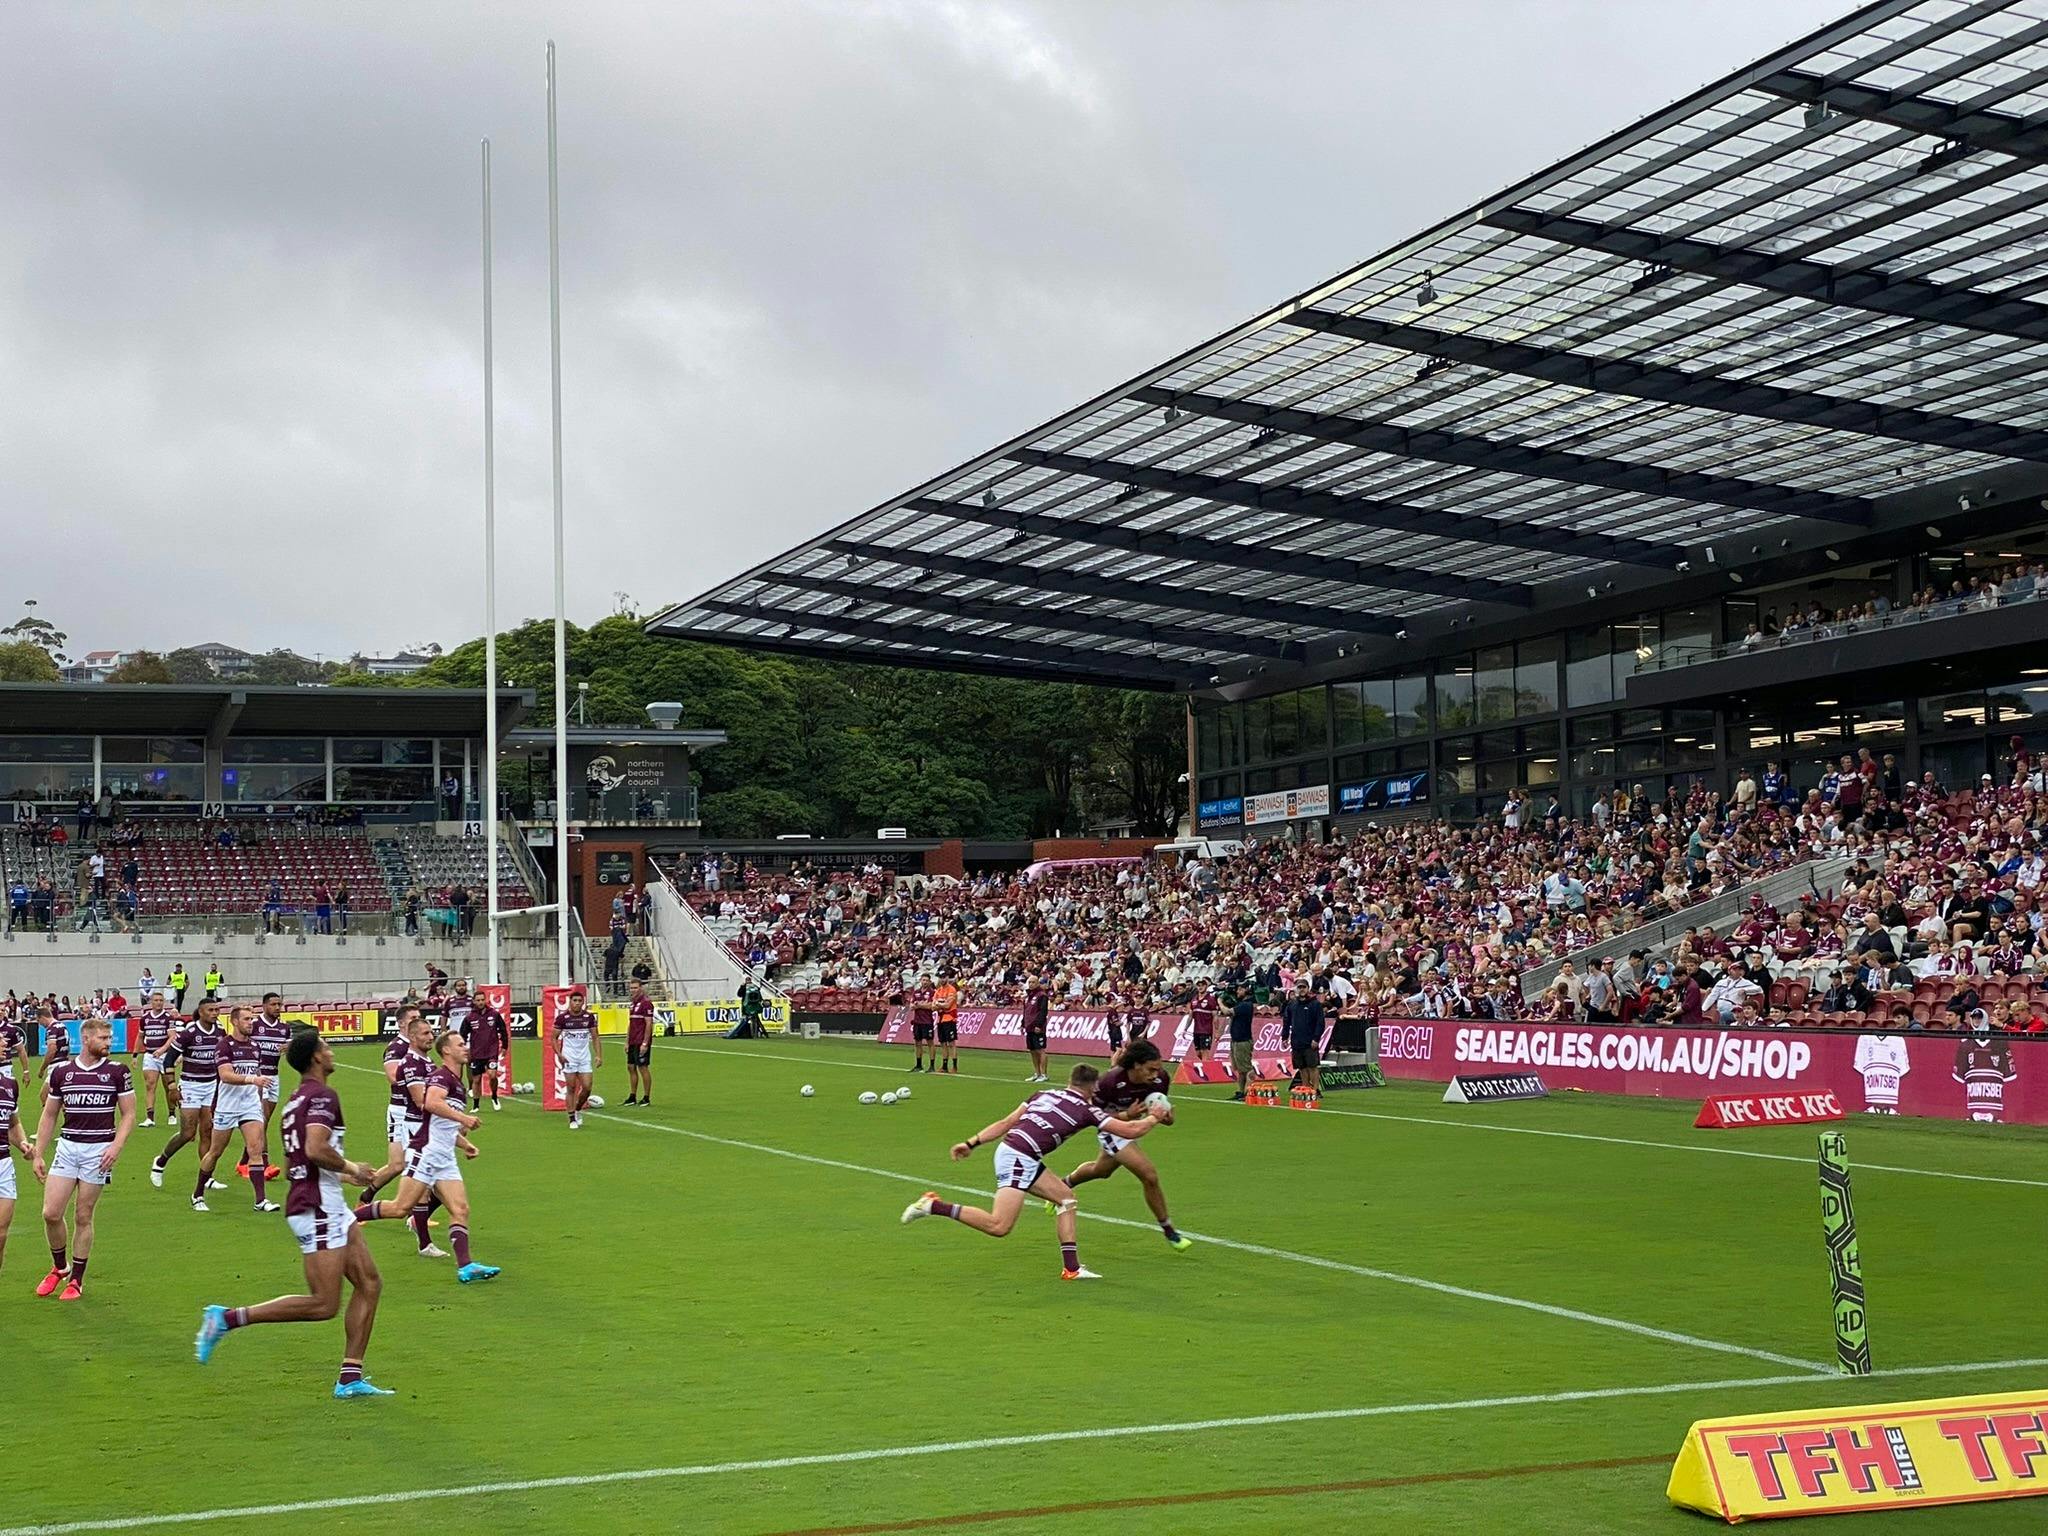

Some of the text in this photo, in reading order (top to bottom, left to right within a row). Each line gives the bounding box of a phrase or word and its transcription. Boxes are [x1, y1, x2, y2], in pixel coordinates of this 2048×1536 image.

[627, 760, 664, 768] northern
[627, 769, 664, 777] beaches
[627, 778, 659, 786] council
[1255, 796, 1284, 811] BAYWASH
[1297, 789, 1328, 806] BAYWASH
[17, 803, 33, 818] A1
[205, 803, 222, 818] A2
[1200, 819, 1219, 829] Solutions
[1220, 816, 1241, 826] Solutions
[464, 823, 481, 836] A3
[836, 855, 877, 864] BREWING
[880, 854, 897, 863] CO.
[706, 1007, 739, 1023] URM
[314, 1015, 357, 1032] TFH
[956, 1011, 987, 1035] ERCH
[1378, 1025, 1433, 1060] ERCH
[1454, 1028, 1811, 1080] SEAEAGLES.COM.AU/SHOP
[1333, 1071, 1371, 1085] PROJECTS
[1866, 1074, 1898, 1089] POINTSBET
[1461, 1077, 1544, 1098] SPORTSCRAFT
[1967, 1082, 2003, 1098] POINTSBET
[63, 1093, 111, 1106] POINTSBET
[1716, 1093, 1842, 1124] KFC KFC KFC
[1847, 1250, 1861, 1272] H
[1836, 1309, 1864, 1333] HD
[1725, 1424, 1905, 1500] TFH
[1888, 1427, 1920, 1488] HIRE
[1894, 1489, 1926, 1498] SERVICES
